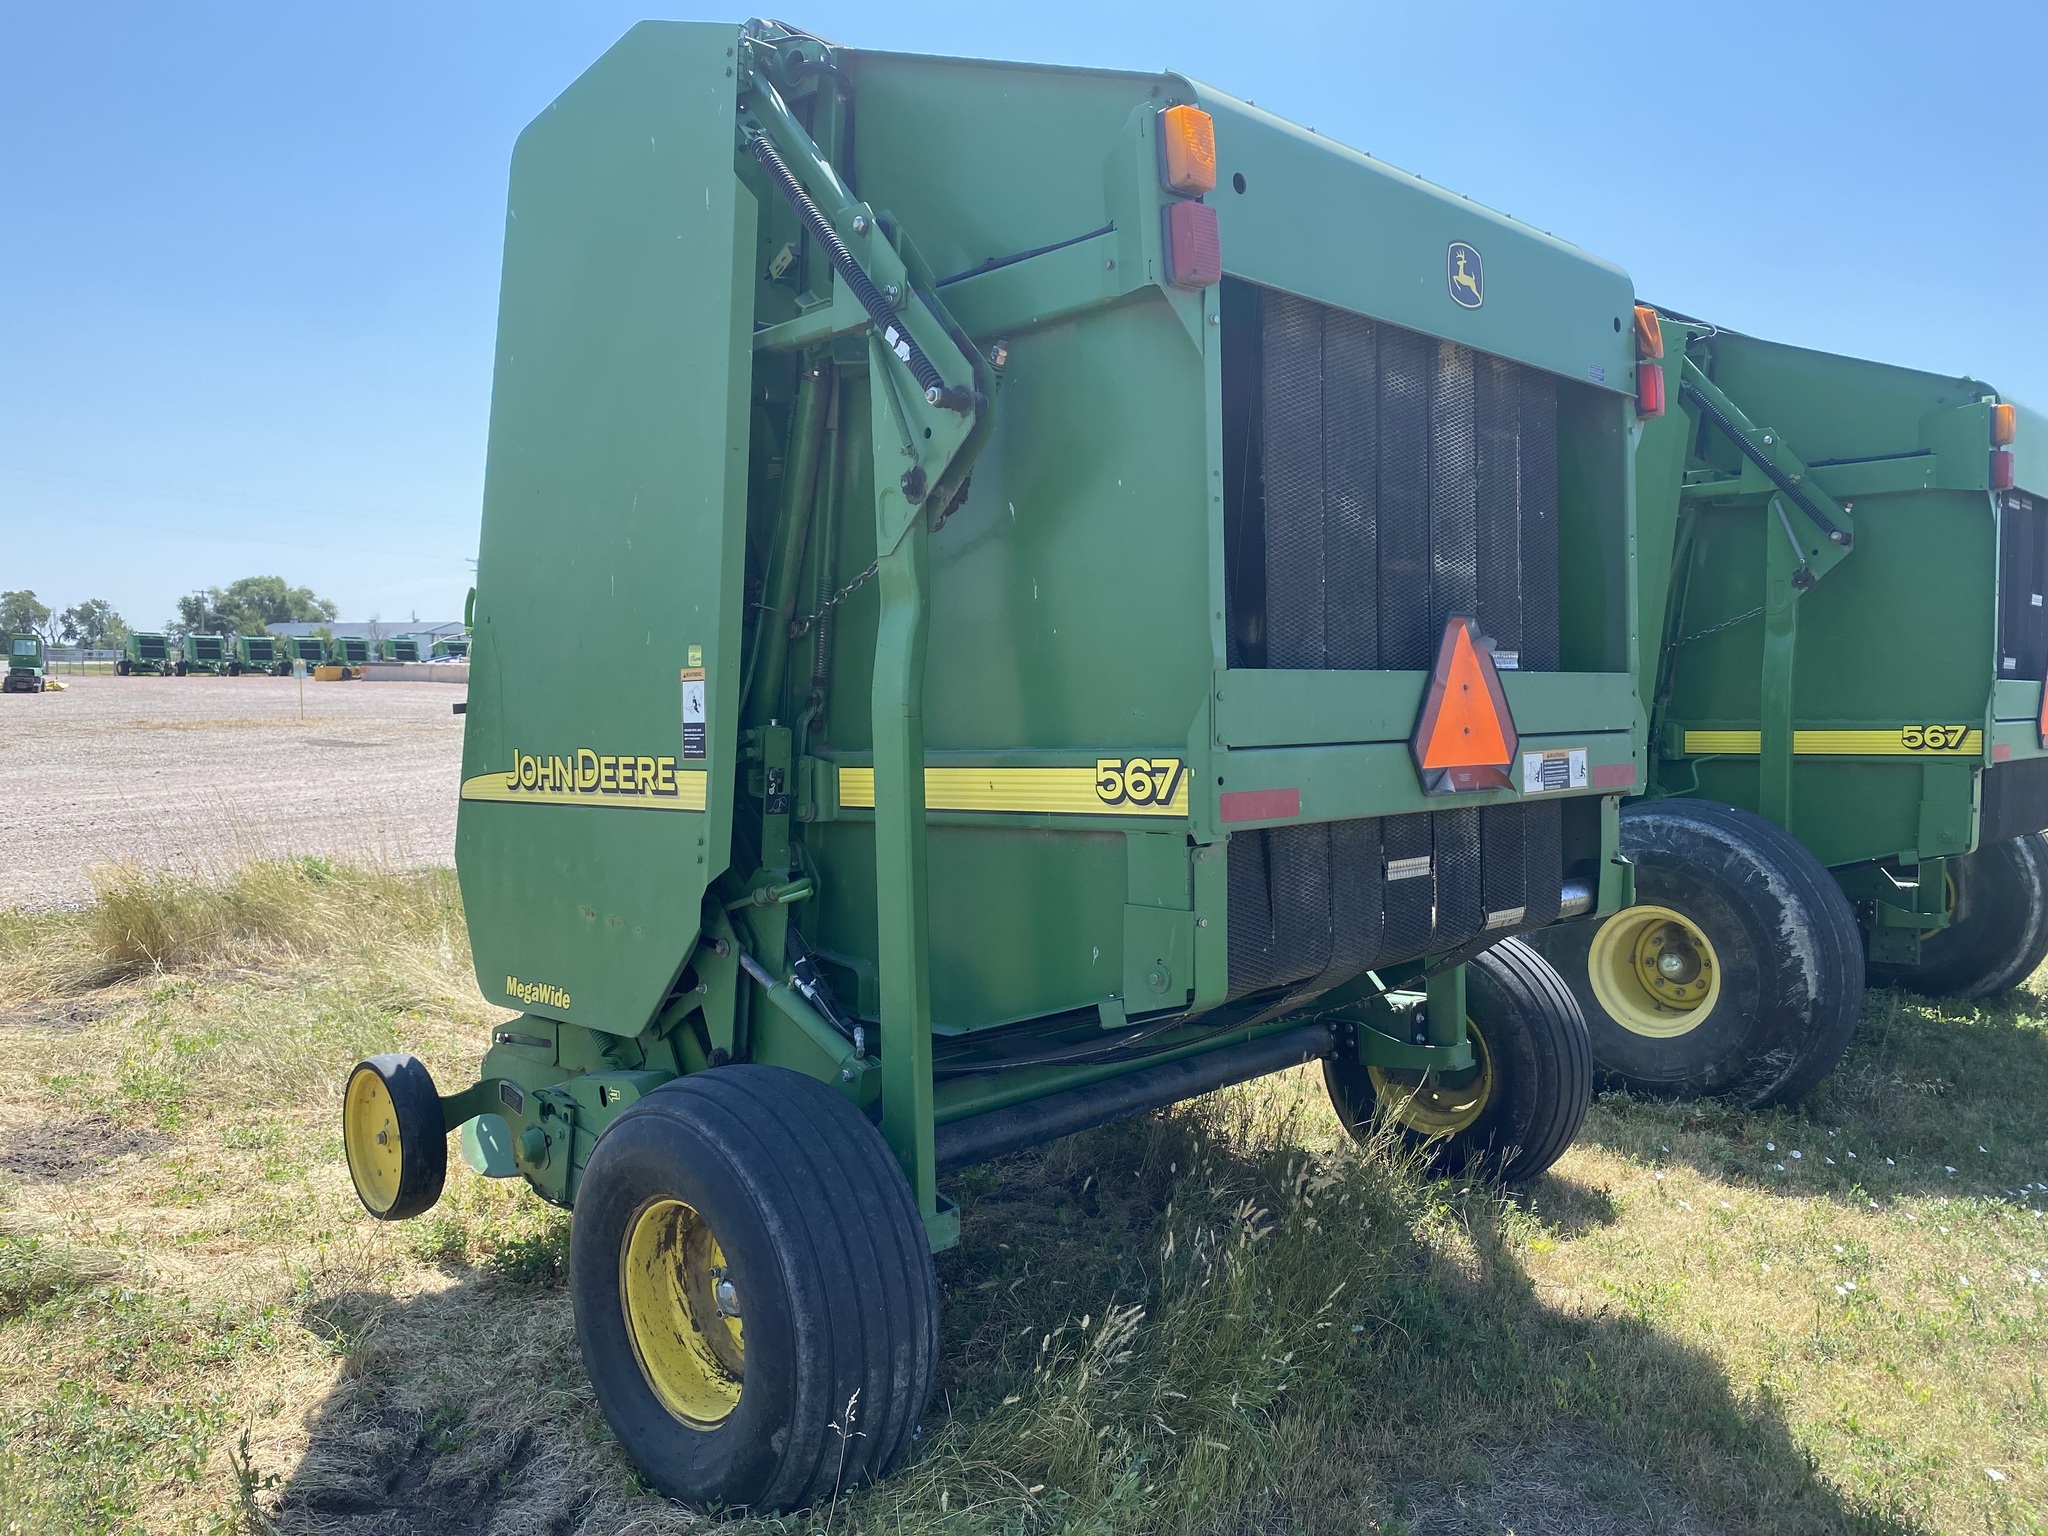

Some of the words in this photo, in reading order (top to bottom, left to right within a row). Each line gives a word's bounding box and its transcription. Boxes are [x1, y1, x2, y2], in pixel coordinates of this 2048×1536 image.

[1901, 724, 1969, 750] 567
[506, 747, 576, 795] JOHN
[577, 747, 679, 798] DEERE
[1095, 757, 1184, 807] 567
[506, 974, 571, 1010] MegaWide
